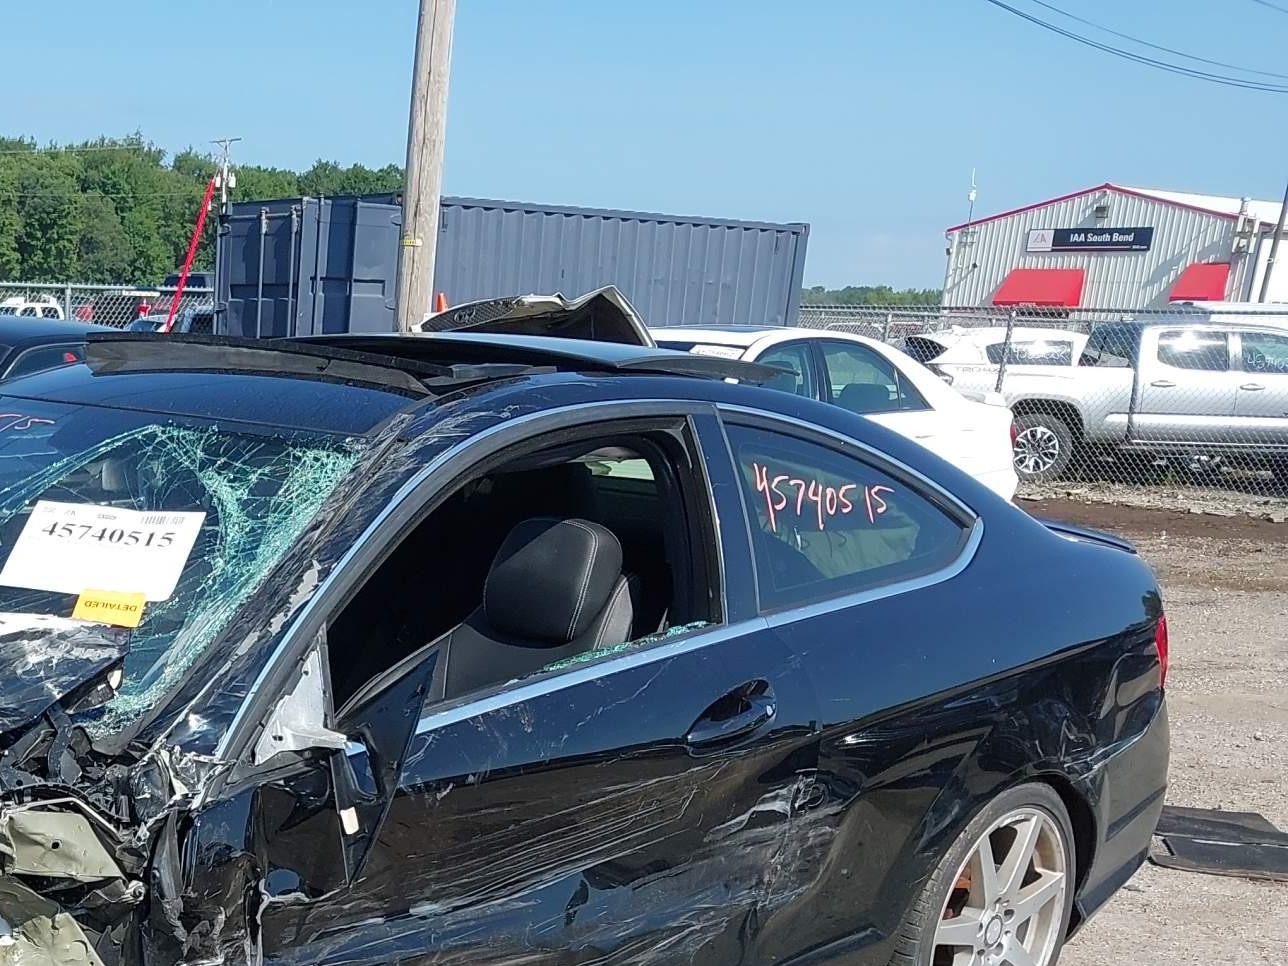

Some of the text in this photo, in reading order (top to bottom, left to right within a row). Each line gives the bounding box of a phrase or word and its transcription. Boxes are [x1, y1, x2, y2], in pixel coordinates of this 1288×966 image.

[1070, 232, 1134, 243] IAA South Bend
[42, 521, 176, 548] 45740515
[84, 600, 138, 612] DETAILED
